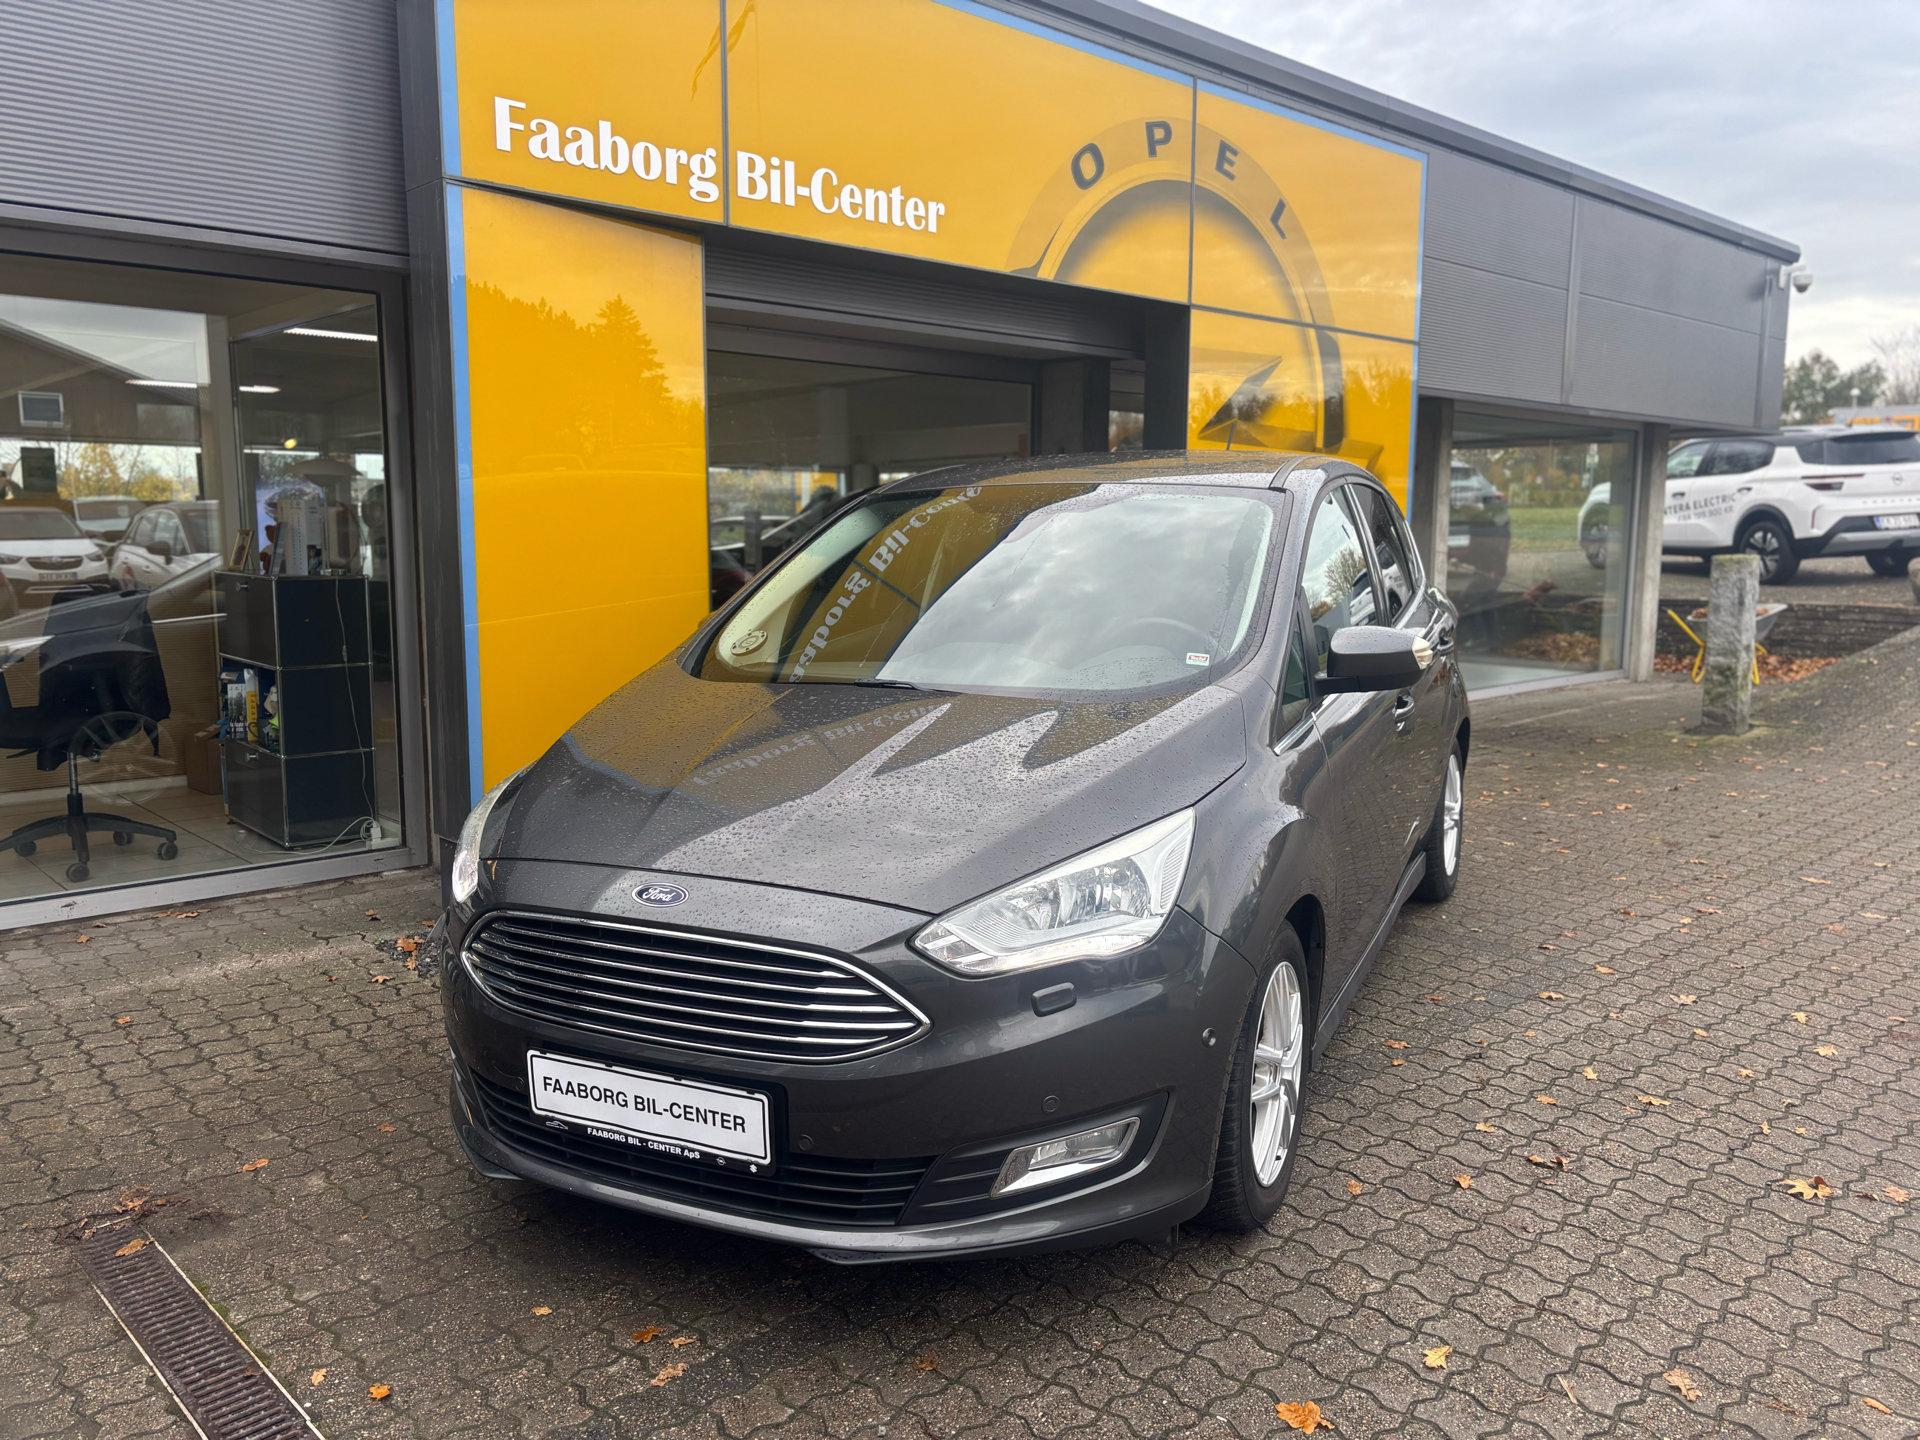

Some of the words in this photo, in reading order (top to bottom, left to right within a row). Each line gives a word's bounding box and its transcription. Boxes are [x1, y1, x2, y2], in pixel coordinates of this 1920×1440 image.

[494, 96, 719, 203] Faaborg
[736, 150, 945, 233] Bil-Center
[1071, 120, 1287, 240] OPEL
[1693, 492, 1737, 510] ELECTRIC
[642, 886, 677, 901] Ford
[542, 1076, 629, 1109] FAABORG
[633, 1094, 747, 1134] BIL-CENTER
[587, 1127, 626, 1143] FAABORG
[627, 1136, 642, 1147] BIL
[647, 1140, 682, 1156] CENTER
[683, 1148, 701, 1160] ApS
